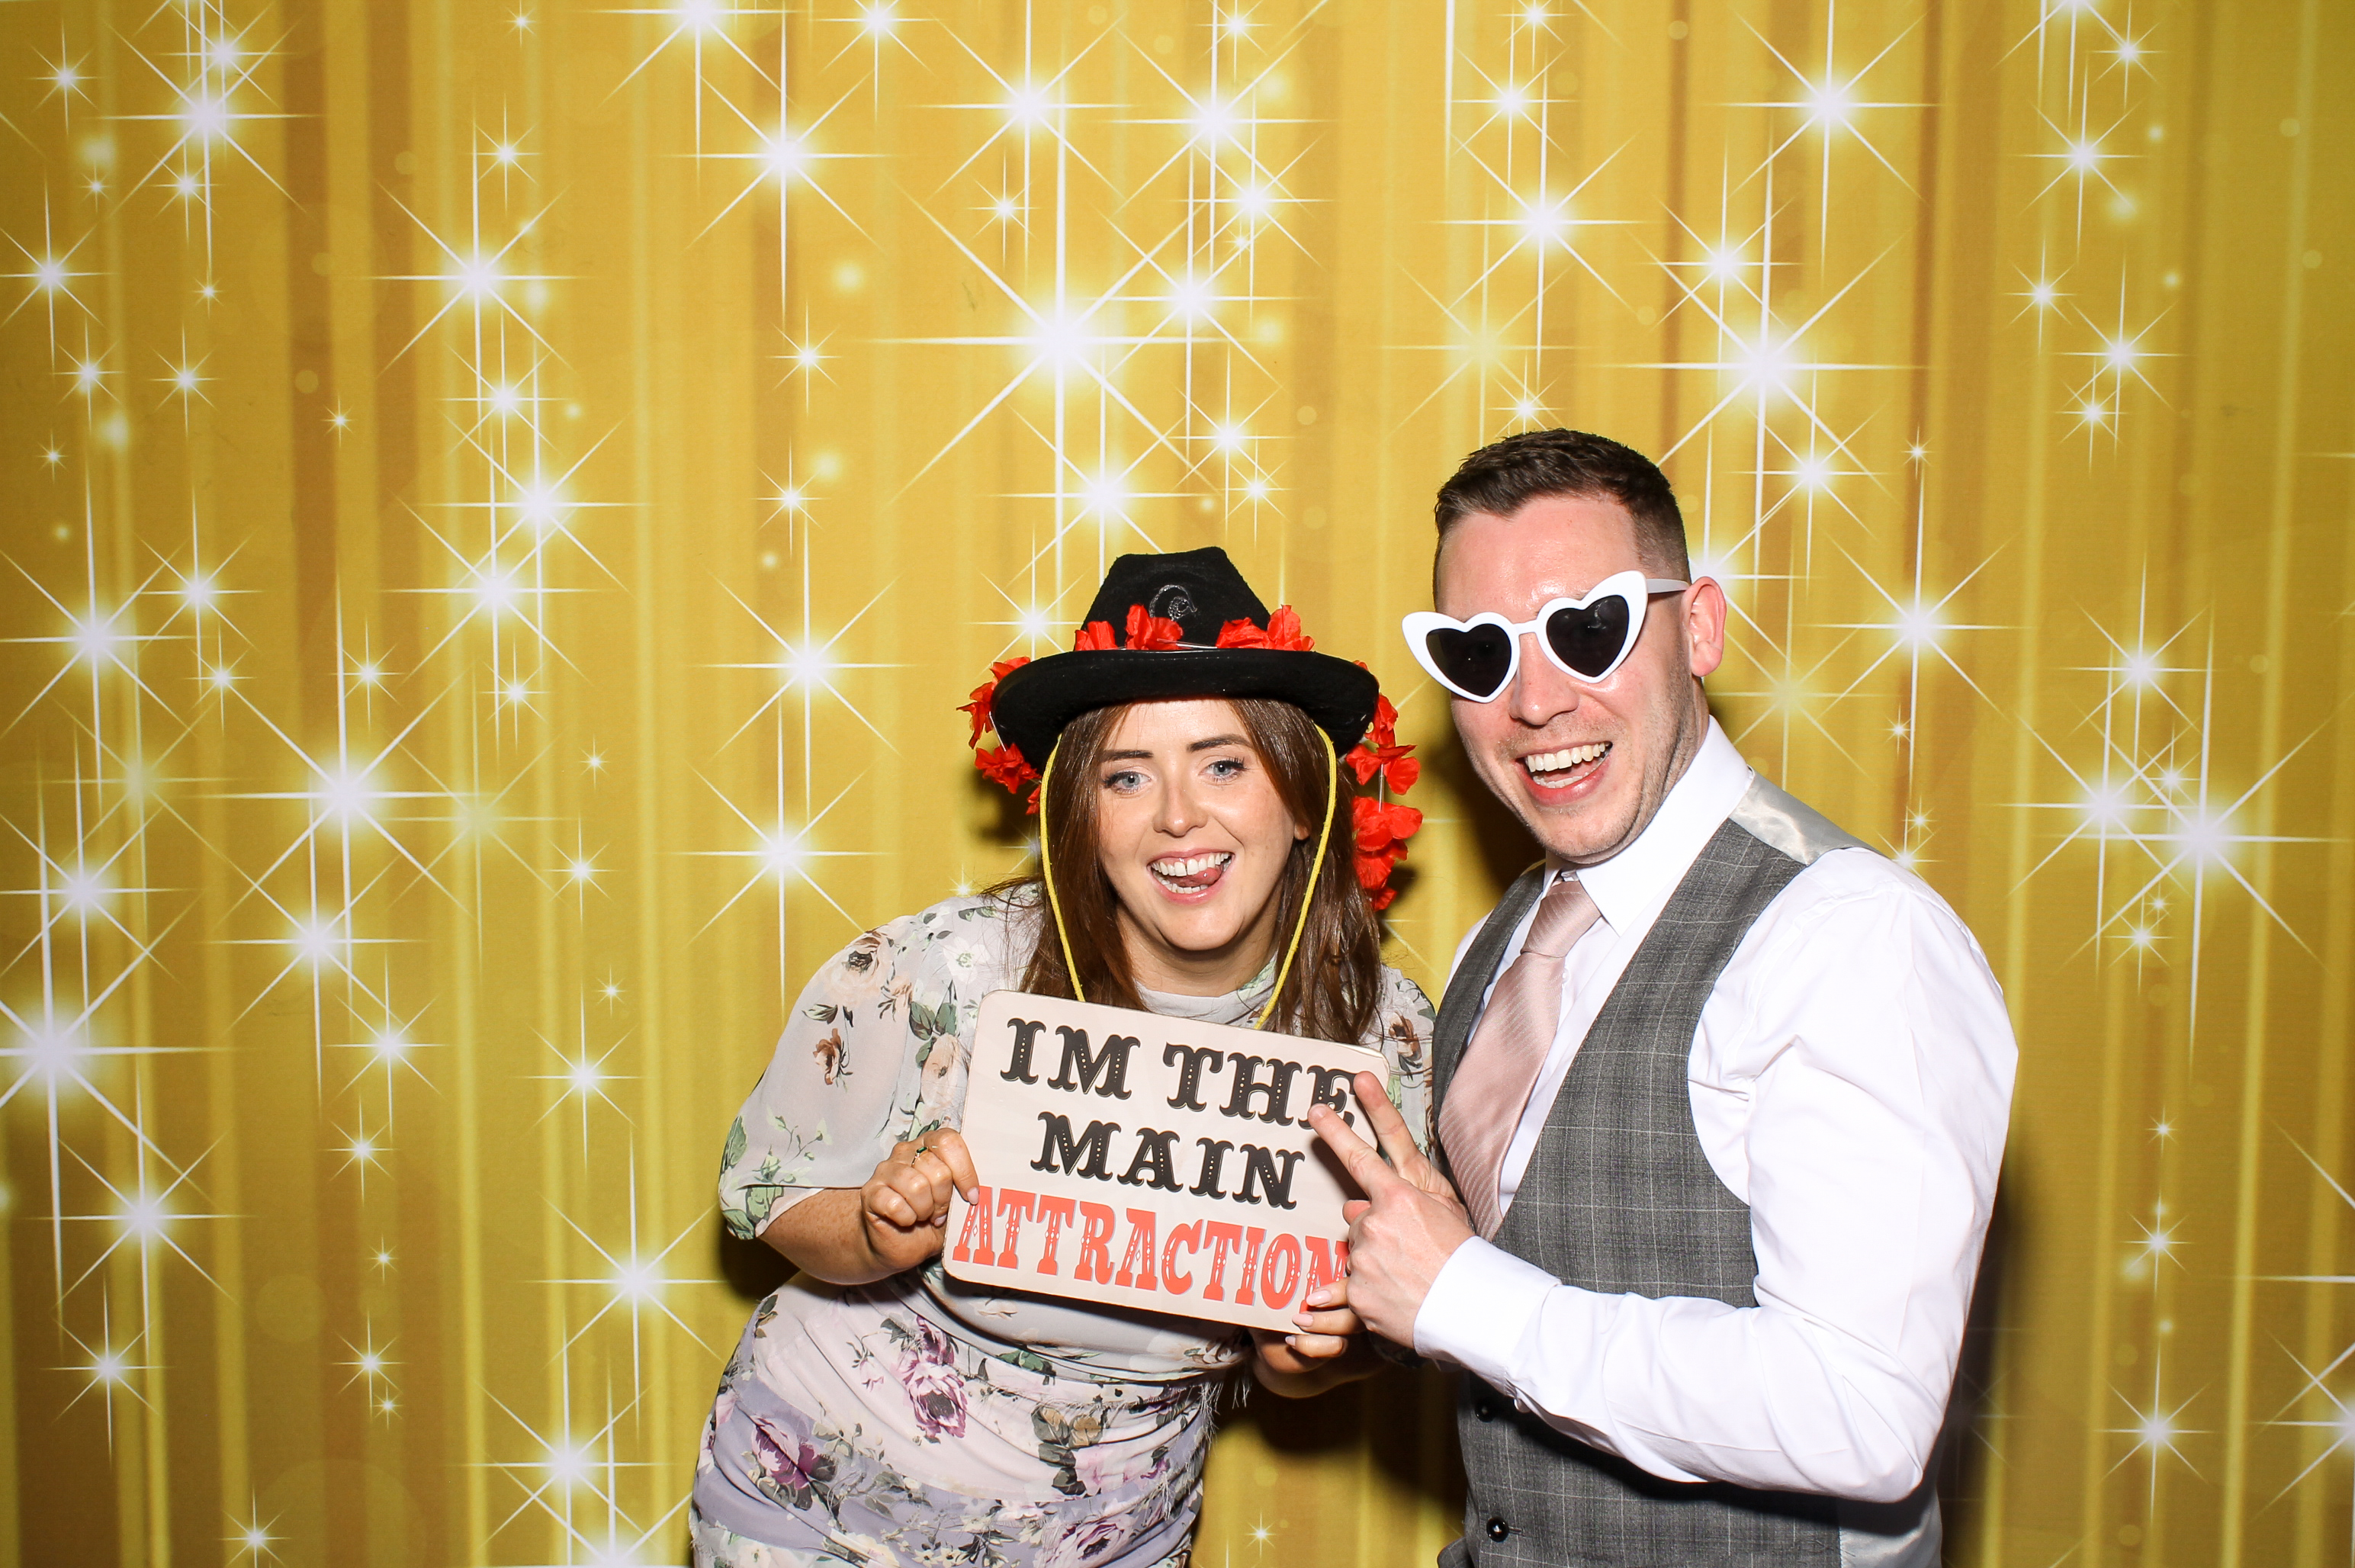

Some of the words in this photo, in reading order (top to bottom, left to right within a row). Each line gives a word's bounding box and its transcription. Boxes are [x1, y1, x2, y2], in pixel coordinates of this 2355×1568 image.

[1000, 1017, 1141, 1100] IM
[1162, 1042, 1356, 1129] THE
[1030, 1111, 1306, 1210] MAIN
[952, 1185, 1348, 1313] ATTRACTION
